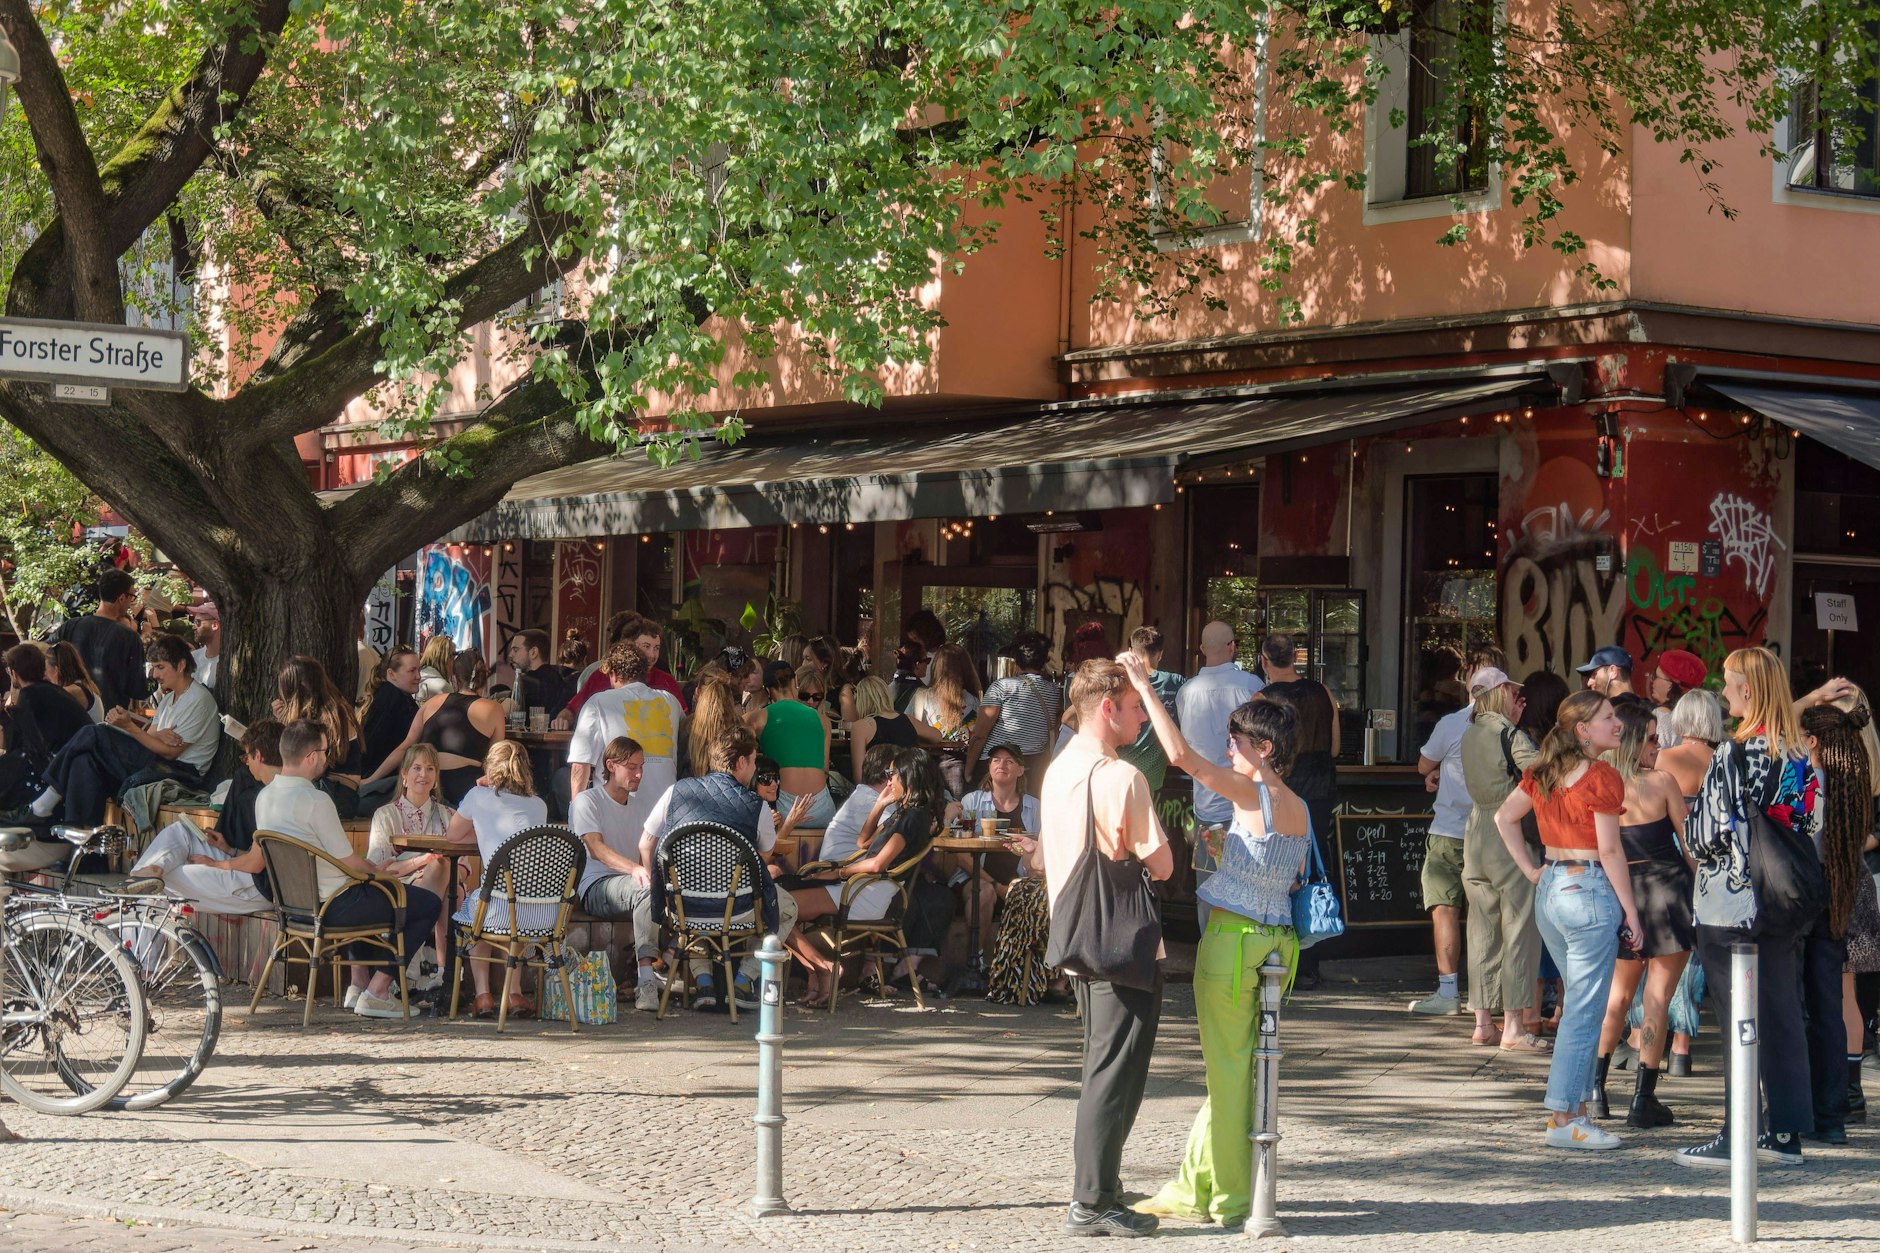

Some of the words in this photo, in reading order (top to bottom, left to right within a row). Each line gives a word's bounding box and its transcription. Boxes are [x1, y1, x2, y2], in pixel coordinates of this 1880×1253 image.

[0, 329, 81, 362] Forster
[90, 337, 163, 373] Straße
[64, 386, 75, 395] 22
[90, 387, 99, 398] 15
[1826, 598, 1847, 608] Staff
[1829, 613, 1848, 624] Only
[1367, 864, 1387, 876] 7-22
[1369, 888, 1392, 900] 8-20
